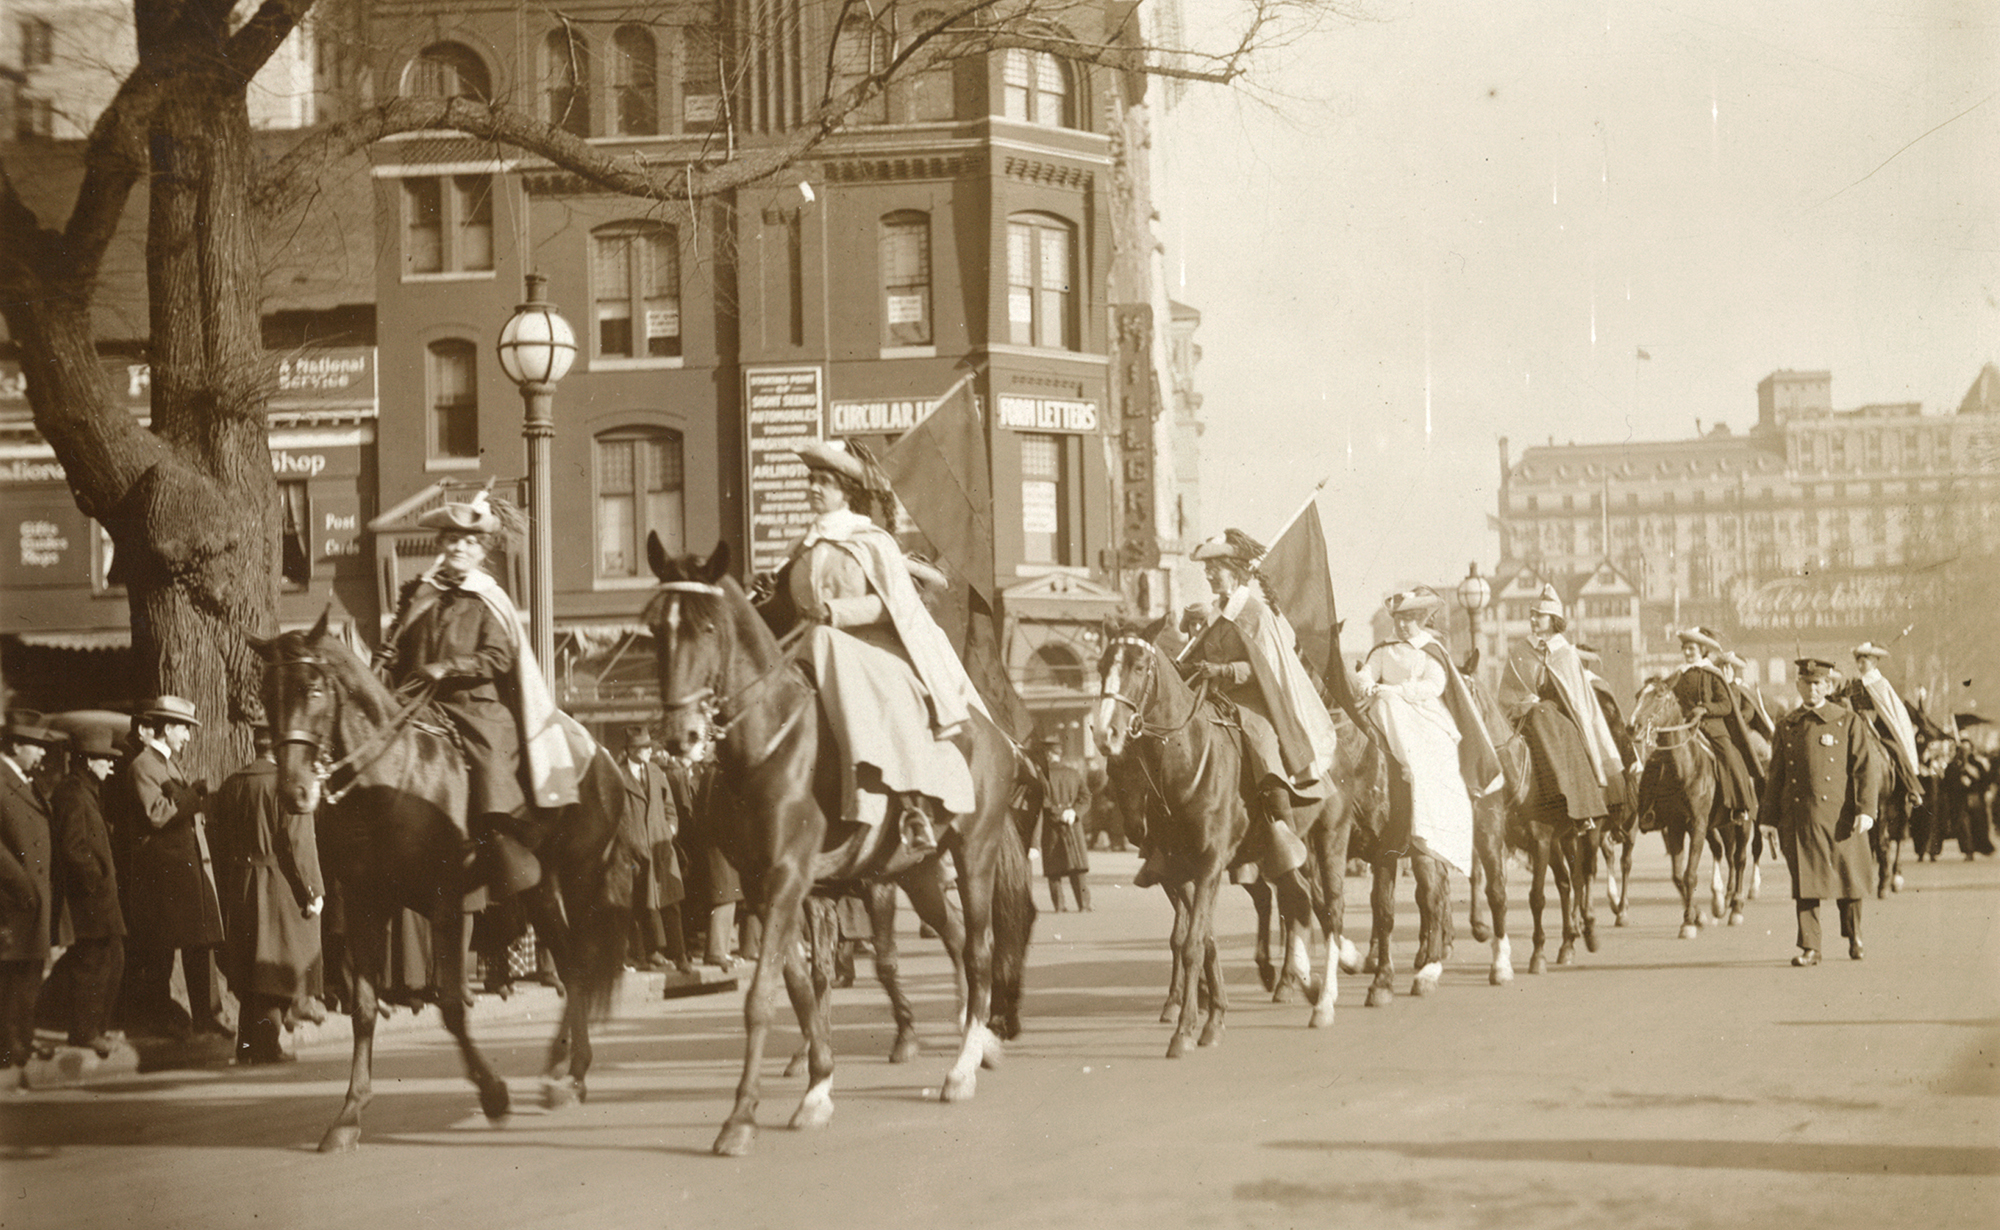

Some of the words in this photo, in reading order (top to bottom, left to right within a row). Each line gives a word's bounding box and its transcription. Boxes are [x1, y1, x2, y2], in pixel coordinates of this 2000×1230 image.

[296, 356, 365, 374] National
[279, 373, 350, 390] Service
[834, 401, 914, 430] CIRCULAR
[1036, 400, 1096, 430] LETTERS
